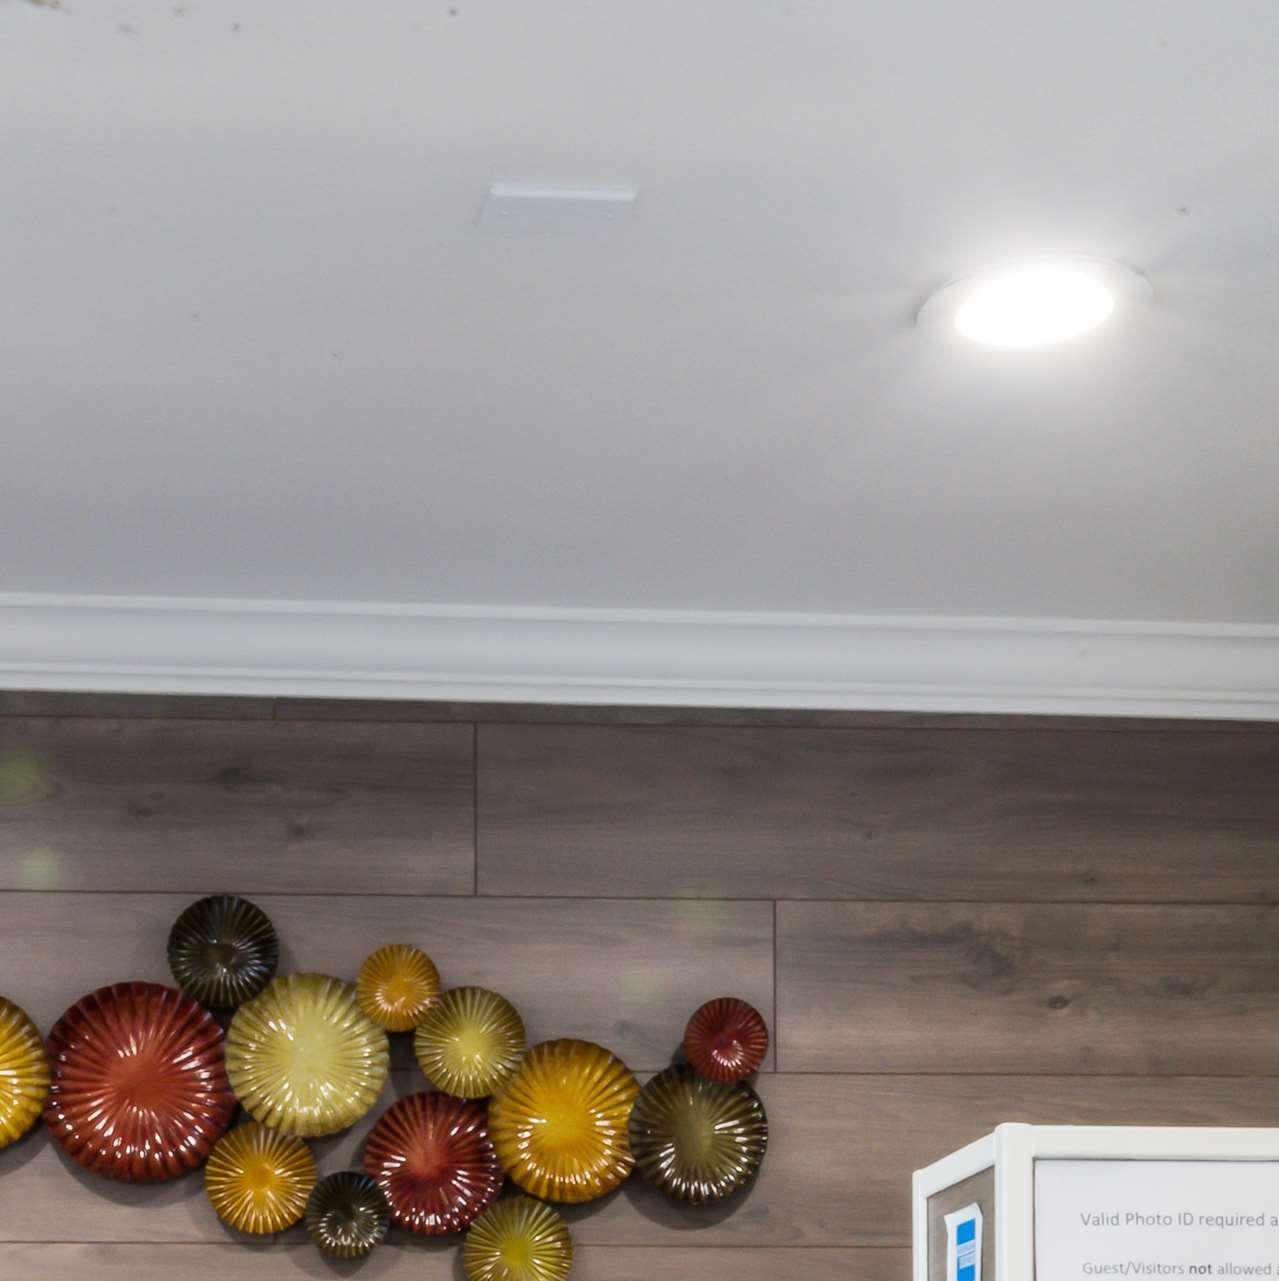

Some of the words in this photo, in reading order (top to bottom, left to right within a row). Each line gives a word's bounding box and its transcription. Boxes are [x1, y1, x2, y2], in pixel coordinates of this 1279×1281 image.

[1079, 1211, 1120, 1227] Valid
[1125, 1211, 1173, 1227] Photo
[1177, 1211, 1195, 1227] ID
[1198, 1211, 1266, 1230] required
[1082, 1260, 1185, 1277] Guest/Visitors
[1188, 1262, 1213, 1276] not
[1216, 1261, 1273, 1276] allowed
